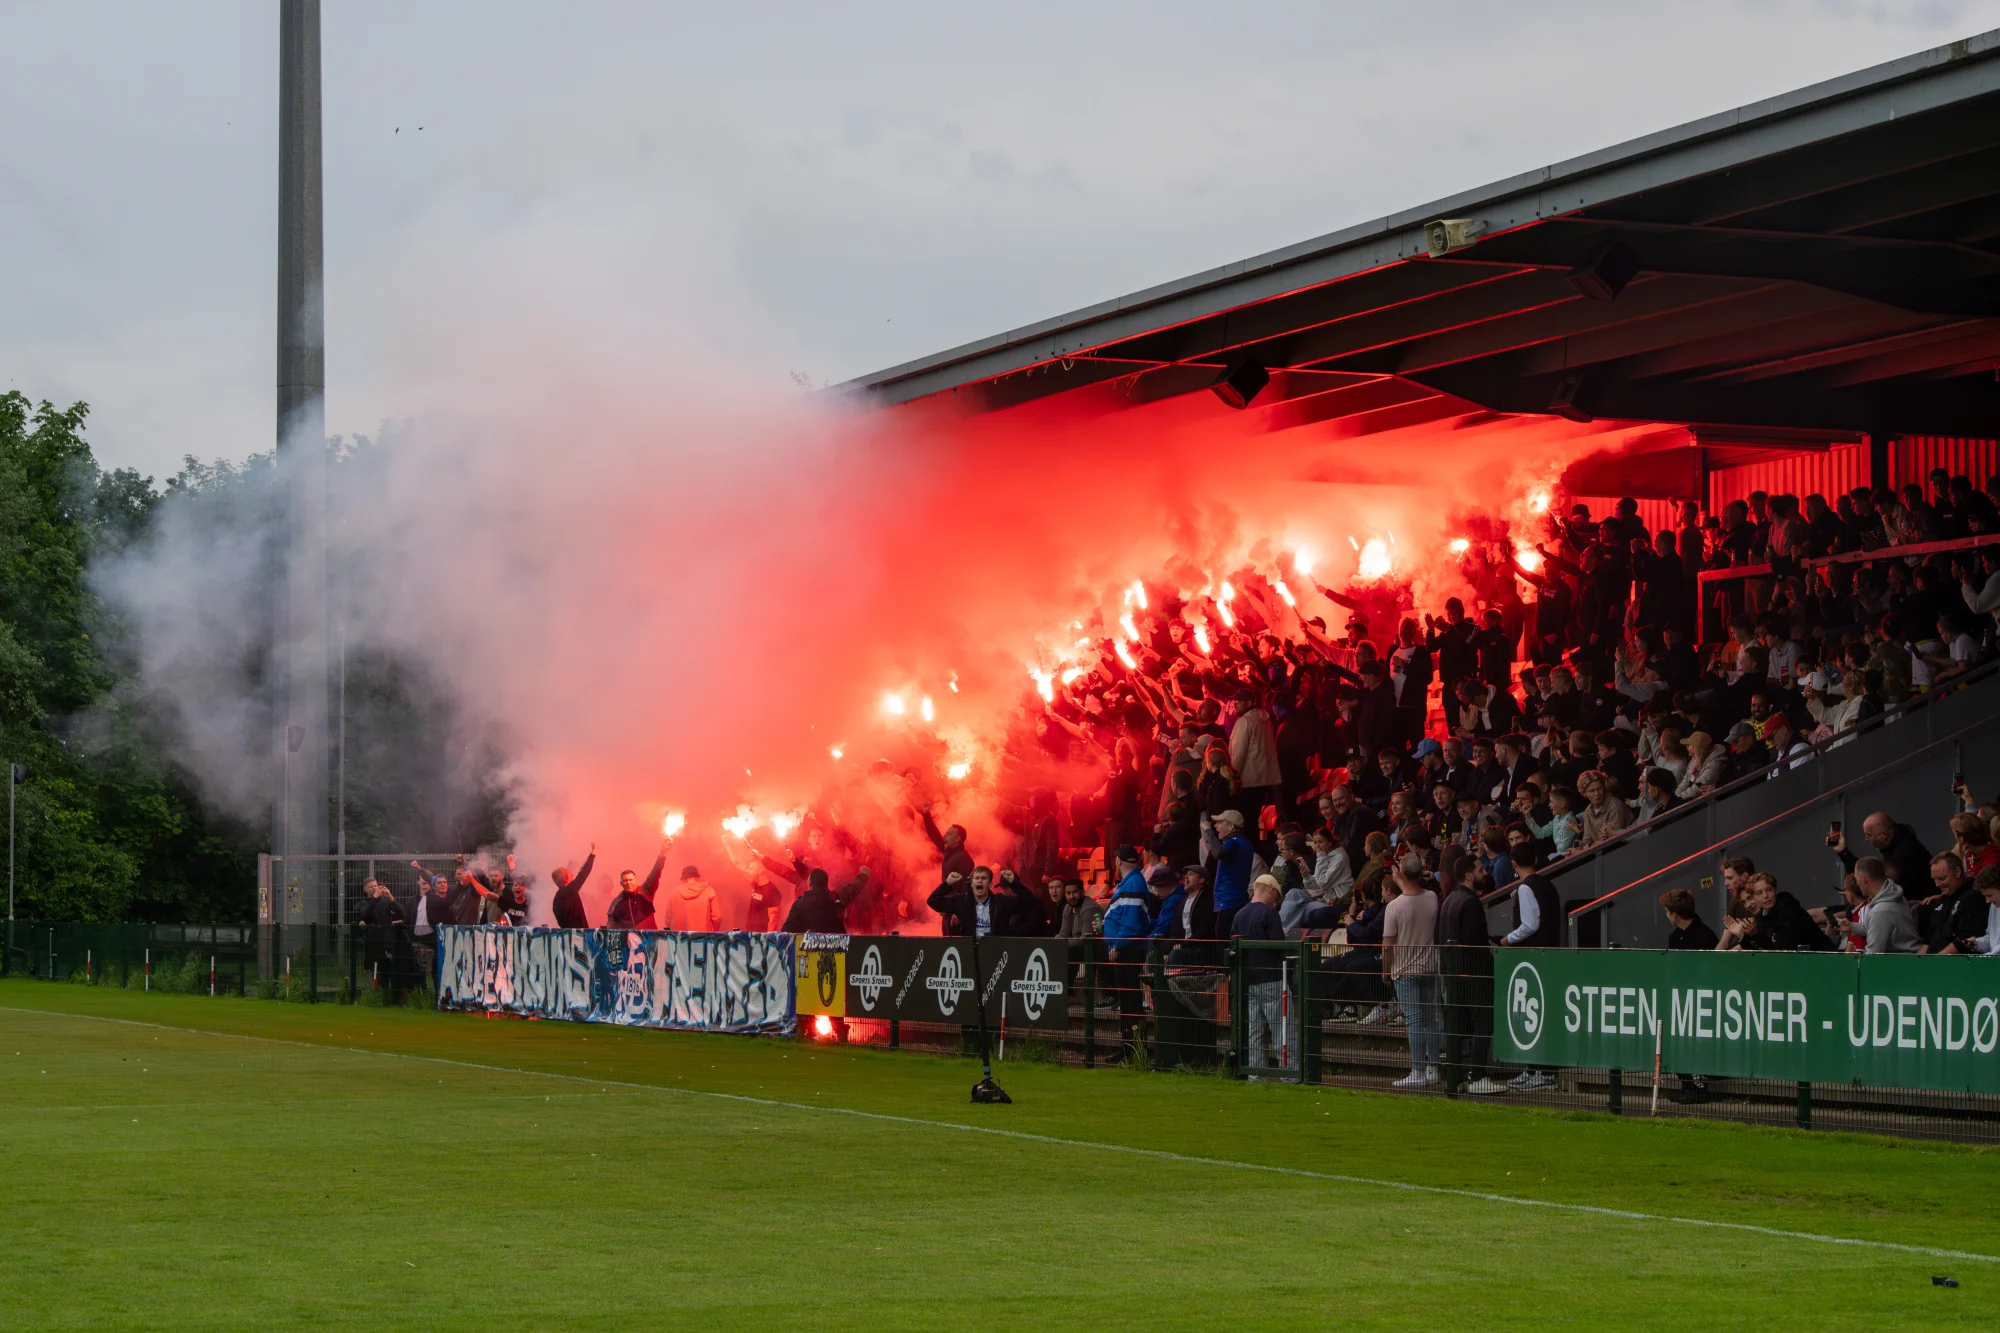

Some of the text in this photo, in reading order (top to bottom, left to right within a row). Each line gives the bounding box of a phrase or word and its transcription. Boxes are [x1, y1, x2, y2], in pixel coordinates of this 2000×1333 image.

[904, 949, 924, 993] FODBOLD
[928, 978, 949, 988] SPORTS
[986, 950, 1009, 996] FODBOLD
[1013, 981, 1036, 991] SPORTS
[1564, 984, 1657, 1036] STEEN
[1670, 988, 1808, 1043] MEISNER
[1847, 994, 1999, 1053] UDENDØ
